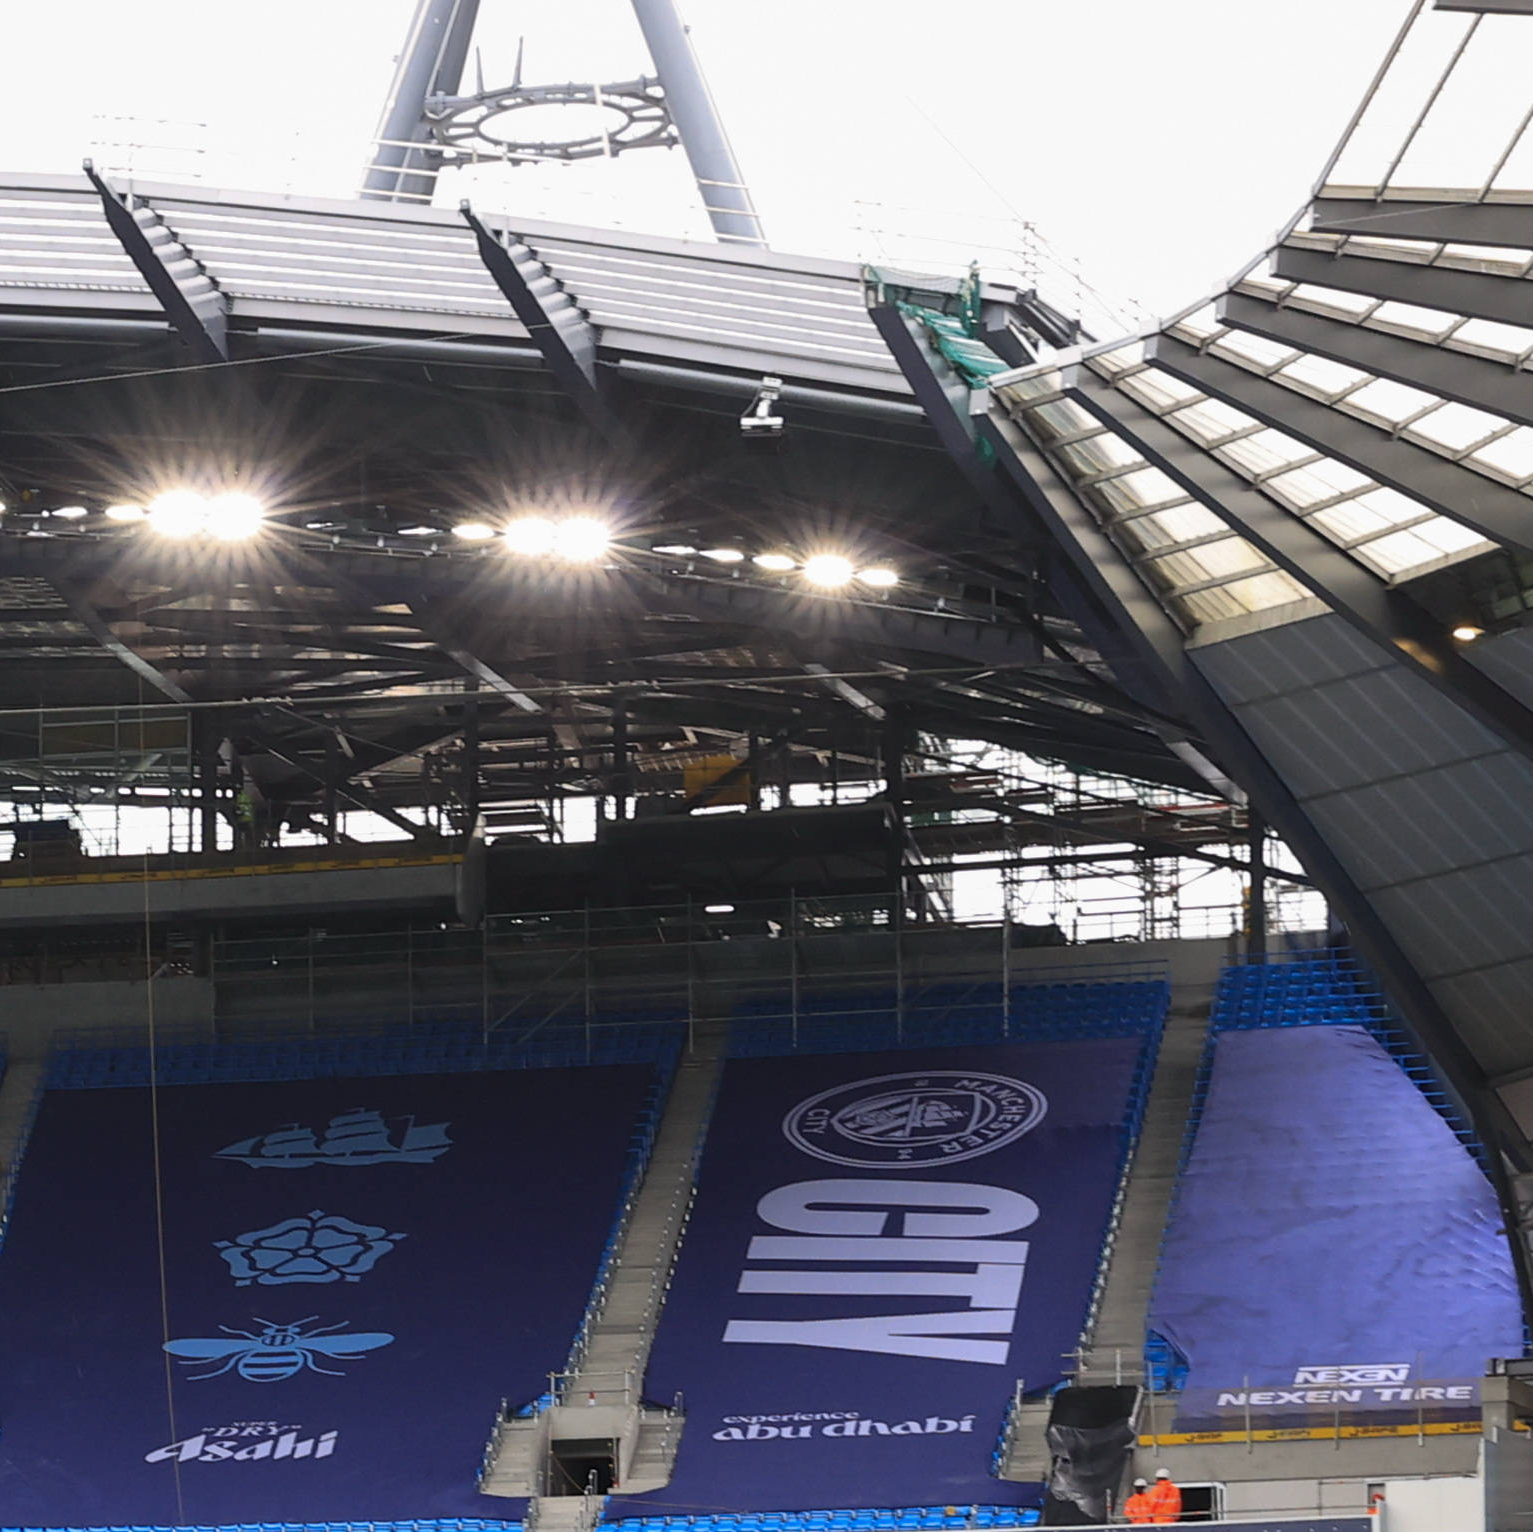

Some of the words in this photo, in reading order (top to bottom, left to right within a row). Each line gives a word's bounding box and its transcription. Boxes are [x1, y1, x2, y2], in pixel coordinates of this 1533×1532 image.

[803, 1108, 830, 1134] CITY
[941, 1079, 1026, 1153] MANCHESTER
[723, 1177, 1040, 1366] CITY
[1217, 1390, 1362, 1406] NEXEN
[1373, 1386, 1474, 1401] TIRE
[712, 1423, 813, 1441] abu
[822, 1415, 976, 1437] dhabi
[722, 1411, 859, 1425] experience
[145, 1430, 338, 1463] Asahi
